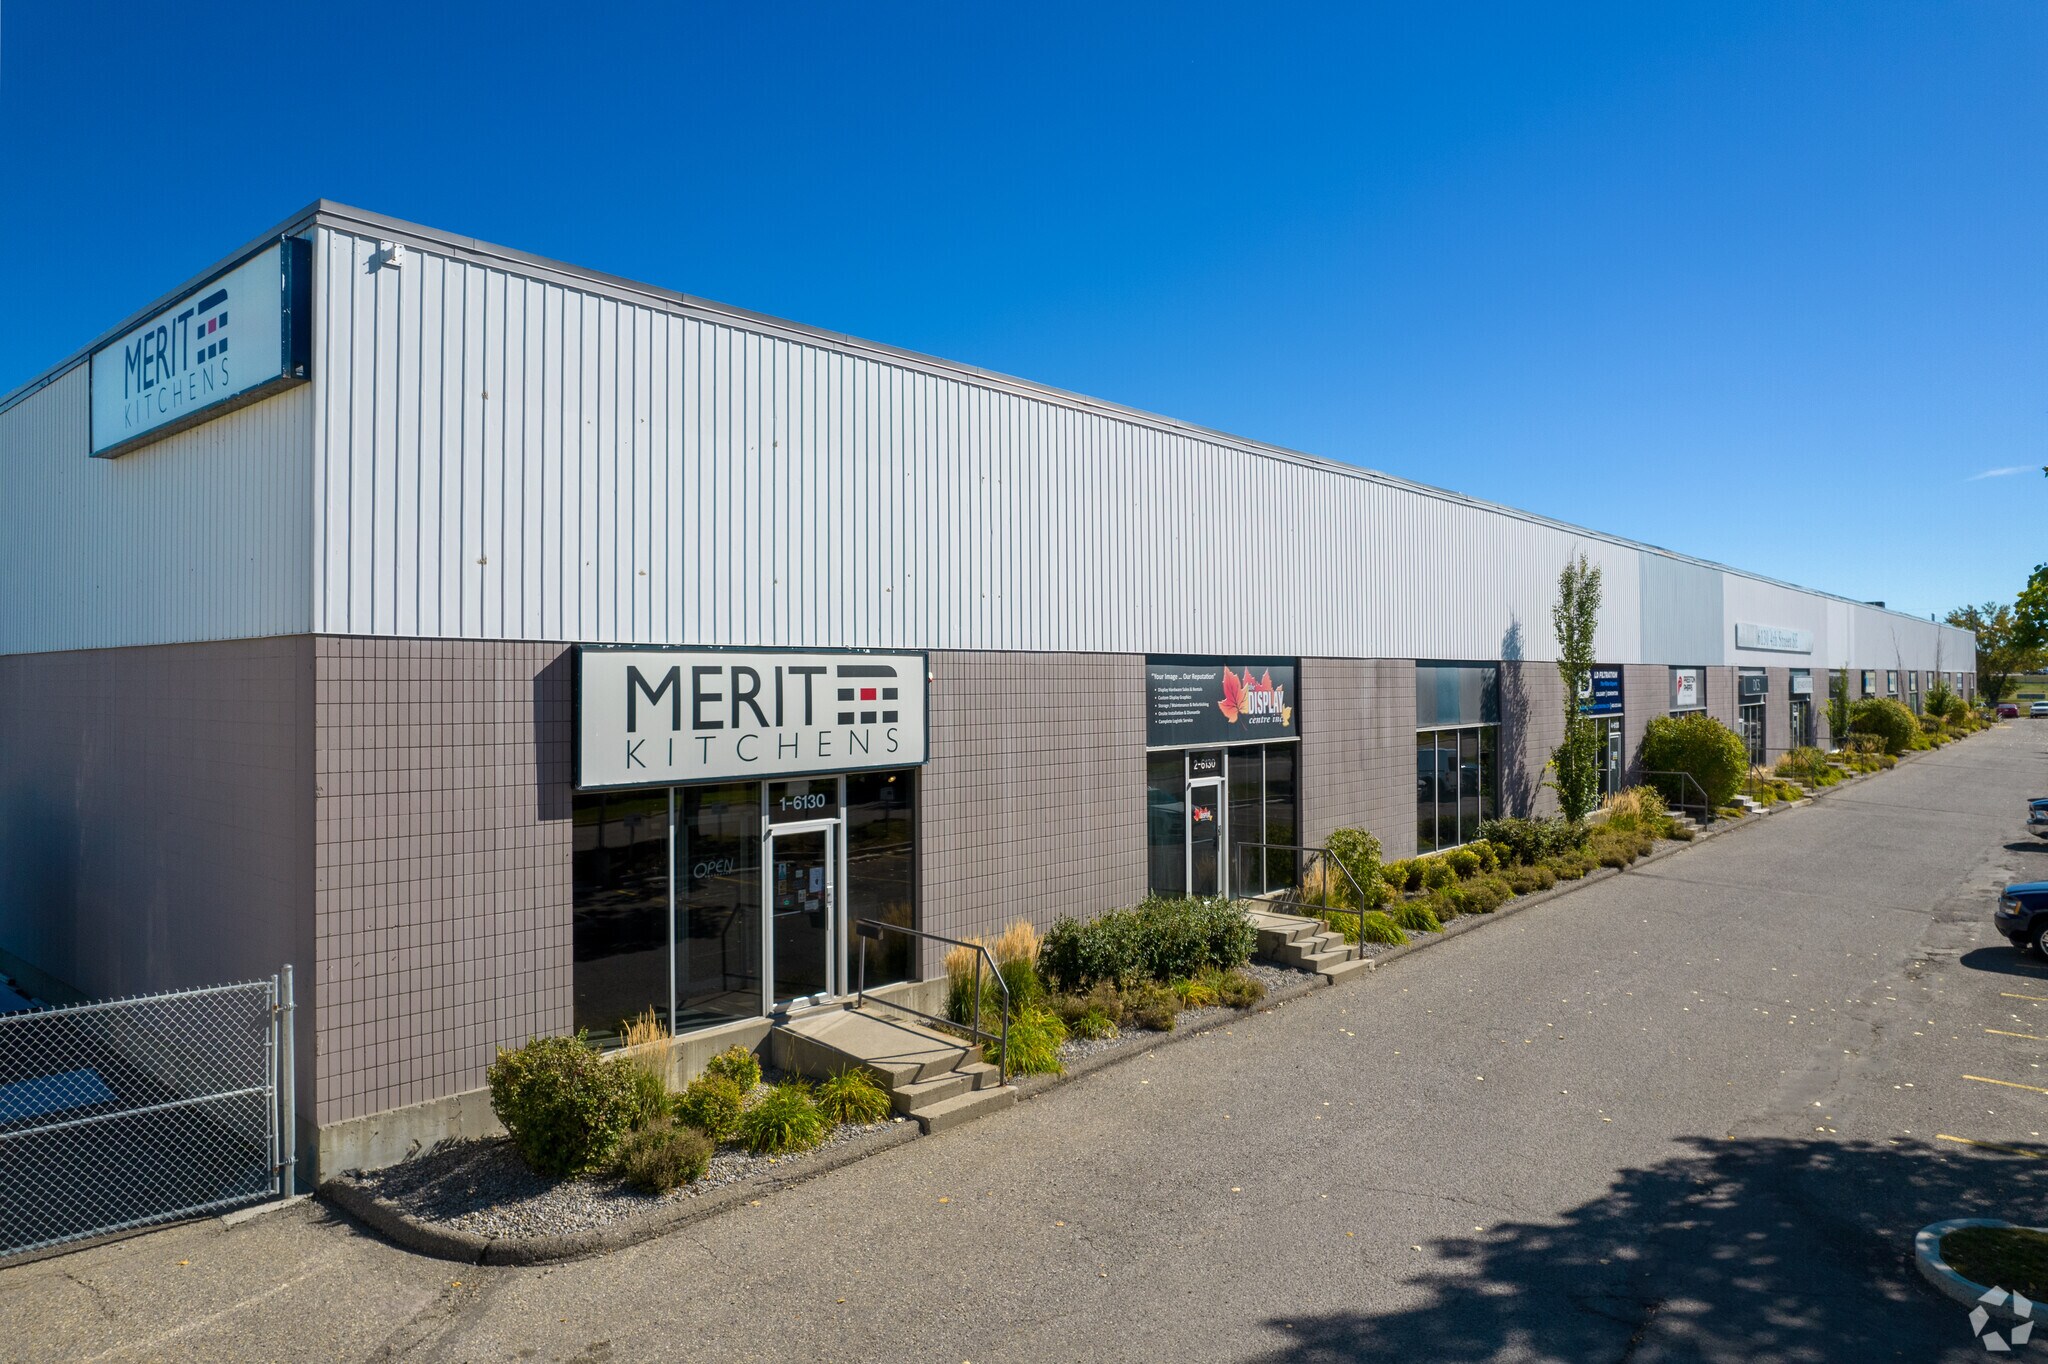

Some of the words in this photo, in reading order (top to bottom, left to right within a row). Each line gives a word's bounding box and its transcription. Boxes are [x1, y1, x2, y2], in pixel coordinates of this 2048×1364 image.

[124, 307, 195, 400] MERIT
[124, 357, 230, 429] KITCHENS
[1164, 673, 1178, 681] Image
[627, 665, 828, 733] MERIT
[1248, 691, 1284, 714] DISPLAY
[1248, 715, 1271, 724] centre
[627, 727, 899, 769] KITCHENS
[1193, 758, 1216, 770] 2-6130
[779, 793, 826, 812] 1-6130
[693, 858, 734, 879] OPEN
